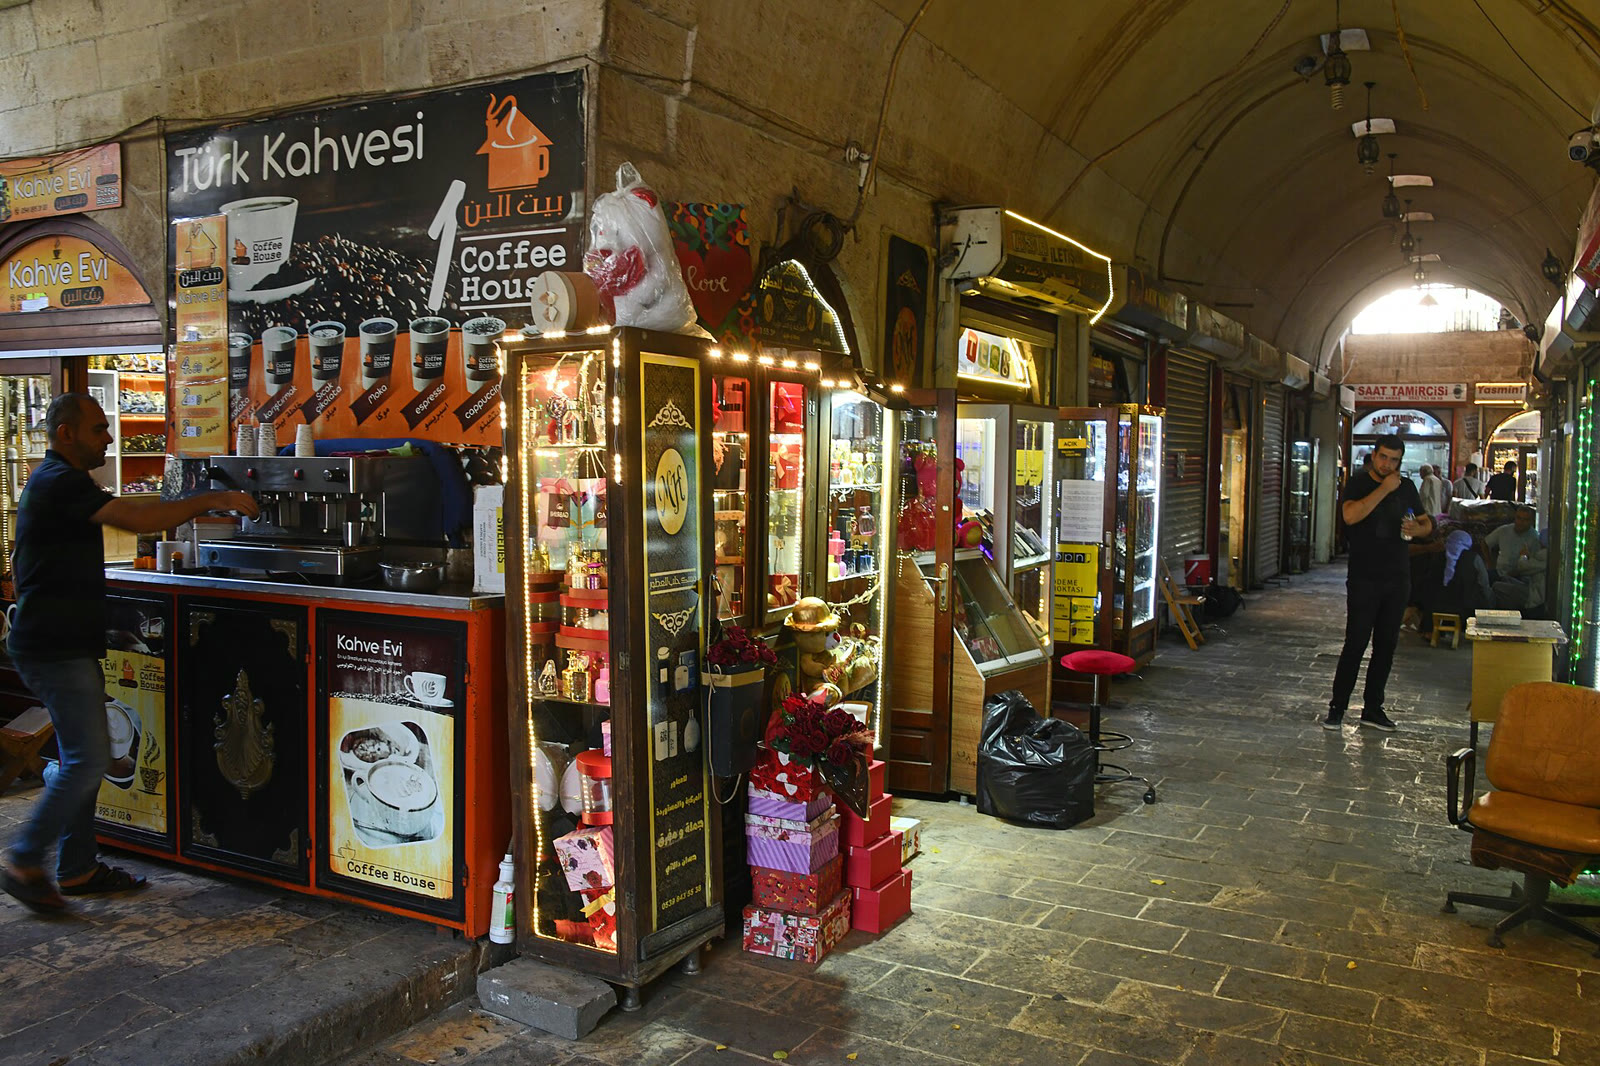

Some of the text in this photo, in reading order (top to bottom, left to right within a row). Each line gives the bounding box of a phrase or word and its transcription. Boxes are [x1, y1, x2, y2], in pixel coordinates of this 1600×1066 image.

[175, 111, 424, 193] Türk Kahvesi
[13, 175, 64, 199] Kahve
[68, 166, 91, 191] Evi
[464, 194, 563, 227] بيت البن
[253, 242, 282, 252] Coffee
[253, 251, 282, 262] House
[460, 241, 566, 273] Coffee
[9, 252, 109, 289] Kahve Evi
[182, 270, 221, 287] بيت البن
[687, 265, 730, 293] love
[459, 277, 540, 301] Hous
[315, 385, 342, 414] çikolata
[368, 384, 388, 405] Moka
[415, 383, 446, 415] espresso
[464, 383, 501, 419] cappuccin
[1358, 386, 1387, 396] SAAT
[1371, 415, 1391, 426] SAAT
[337, 634, 403, 657] Kahve Evi
[105, 659, 116, 671] Evi
[140, 672, 165, 682] Coffee
[140, 680, 165, 690] House
[99, 806, 109, 816] 895
[347, 861, 436, 891] Coffee House
